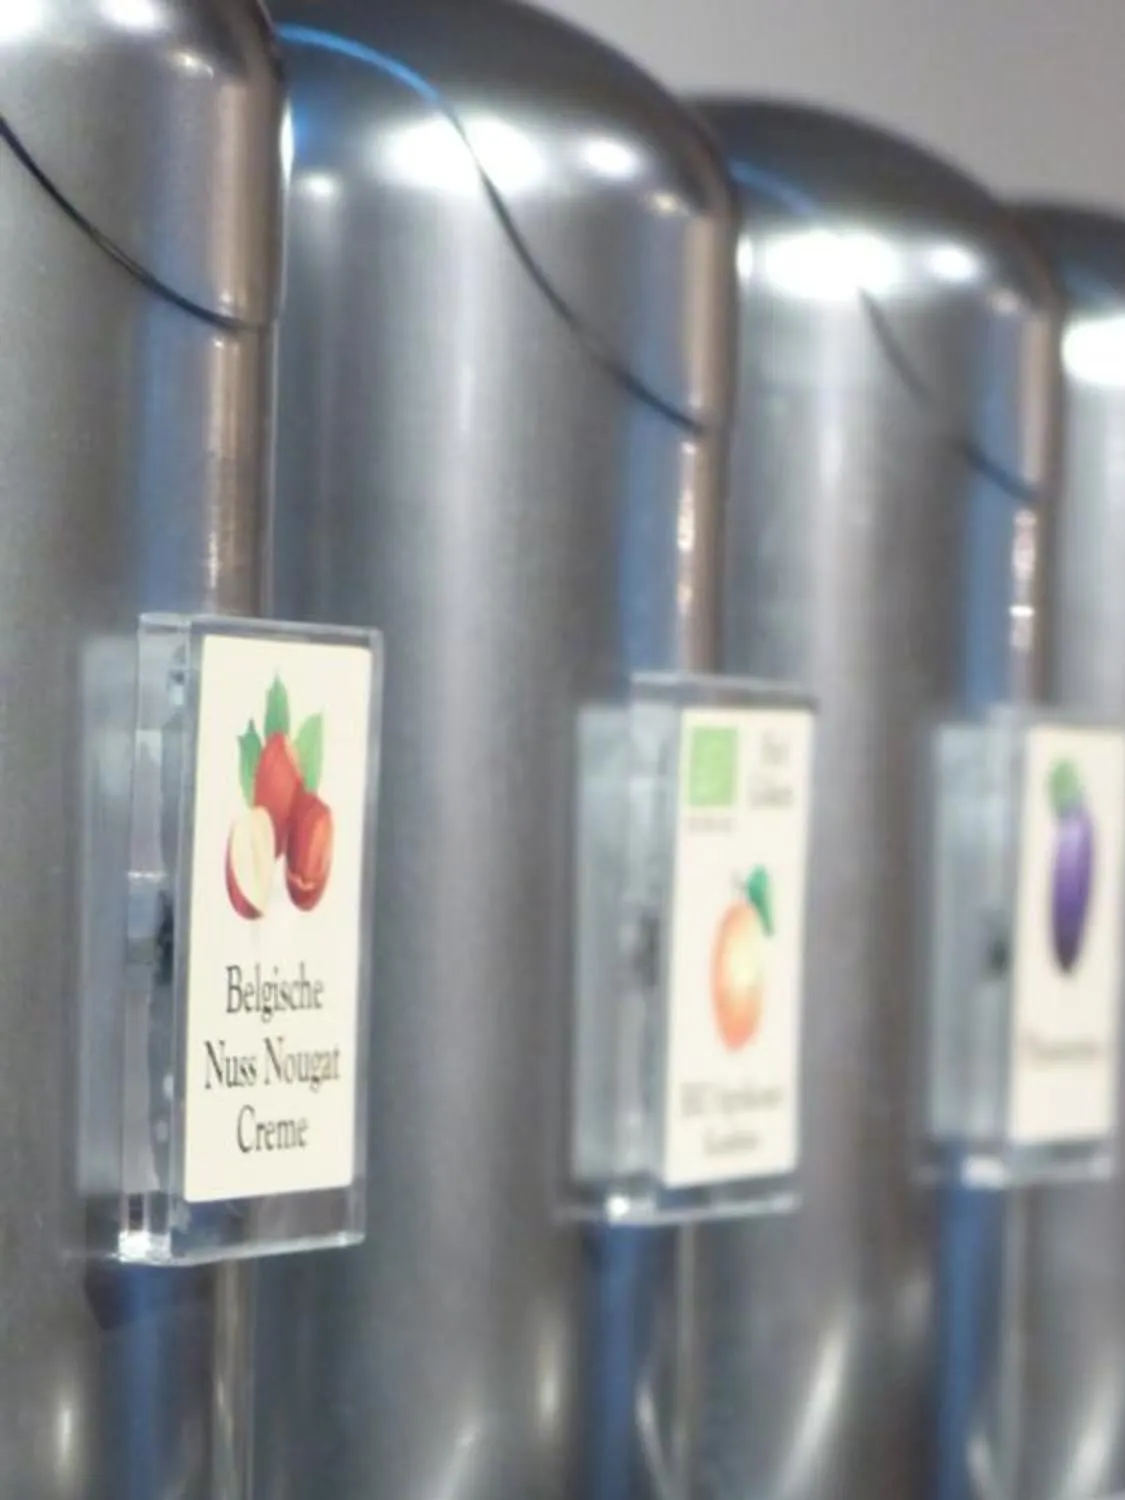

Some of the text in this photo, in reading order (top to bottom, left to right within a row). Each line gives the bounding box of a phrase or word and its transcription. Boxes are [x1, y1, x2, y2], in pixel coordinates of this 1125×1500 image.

[225, 962, 324, 1023] Belgische
[204, 1035, 341, 1093] Nuss Nougat
[236, 1104, 309, 1154] Creme
